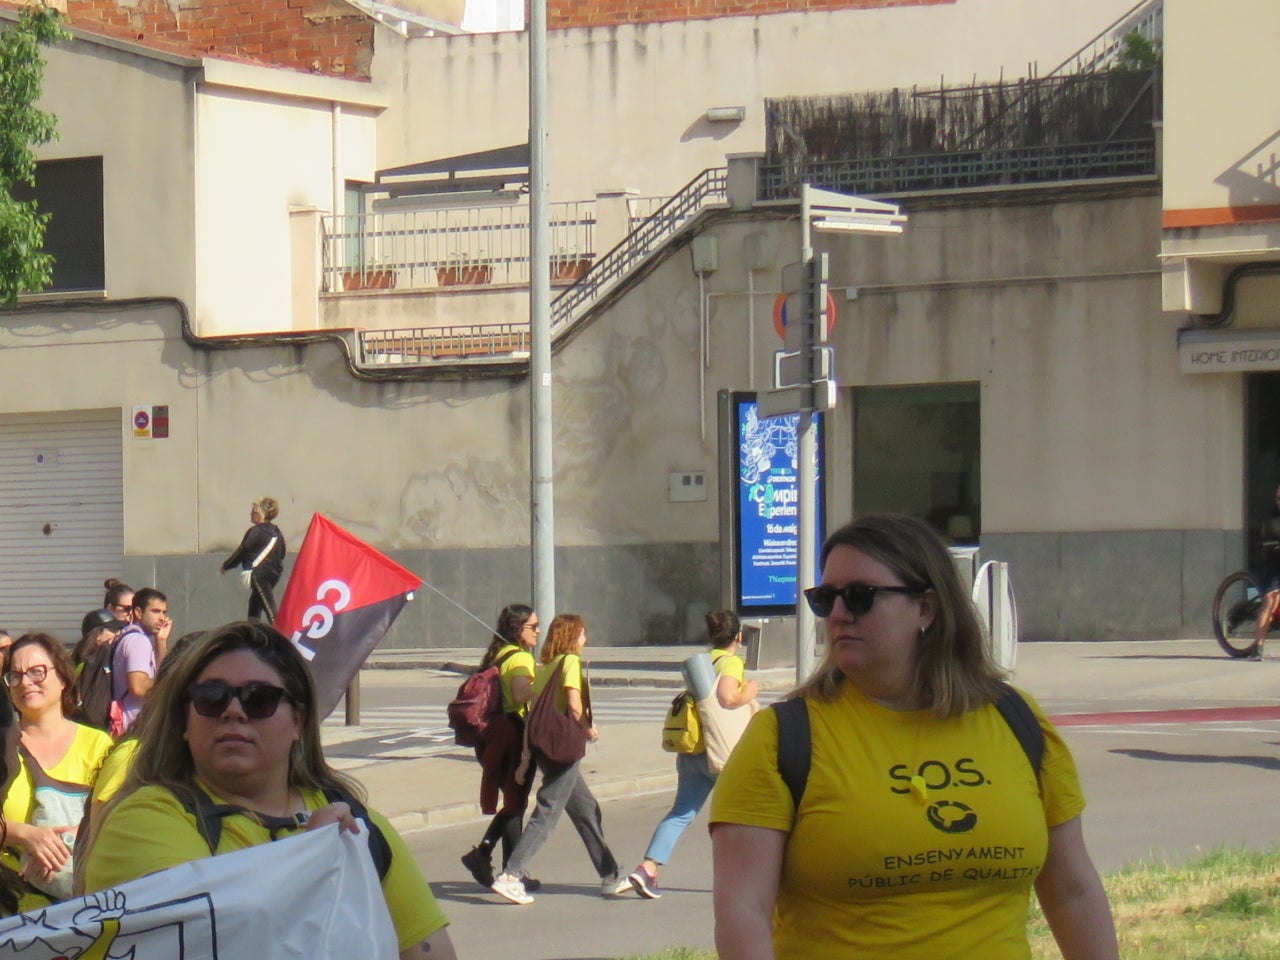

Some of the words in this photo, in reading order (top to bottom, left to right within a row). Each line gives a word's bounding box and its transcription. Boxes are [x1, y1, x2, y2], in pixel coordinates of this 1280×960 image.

[1191, 351, 1227, 365] HOME
[758, 503, 797, 519] Eperien
[888, 757, 992, 795] SO.S.
[883, 846, 1025, 870] ENSENYAMENT
[847, 873, 922, 890] PÚBLIC
[929, 868, 955, 882] DE
